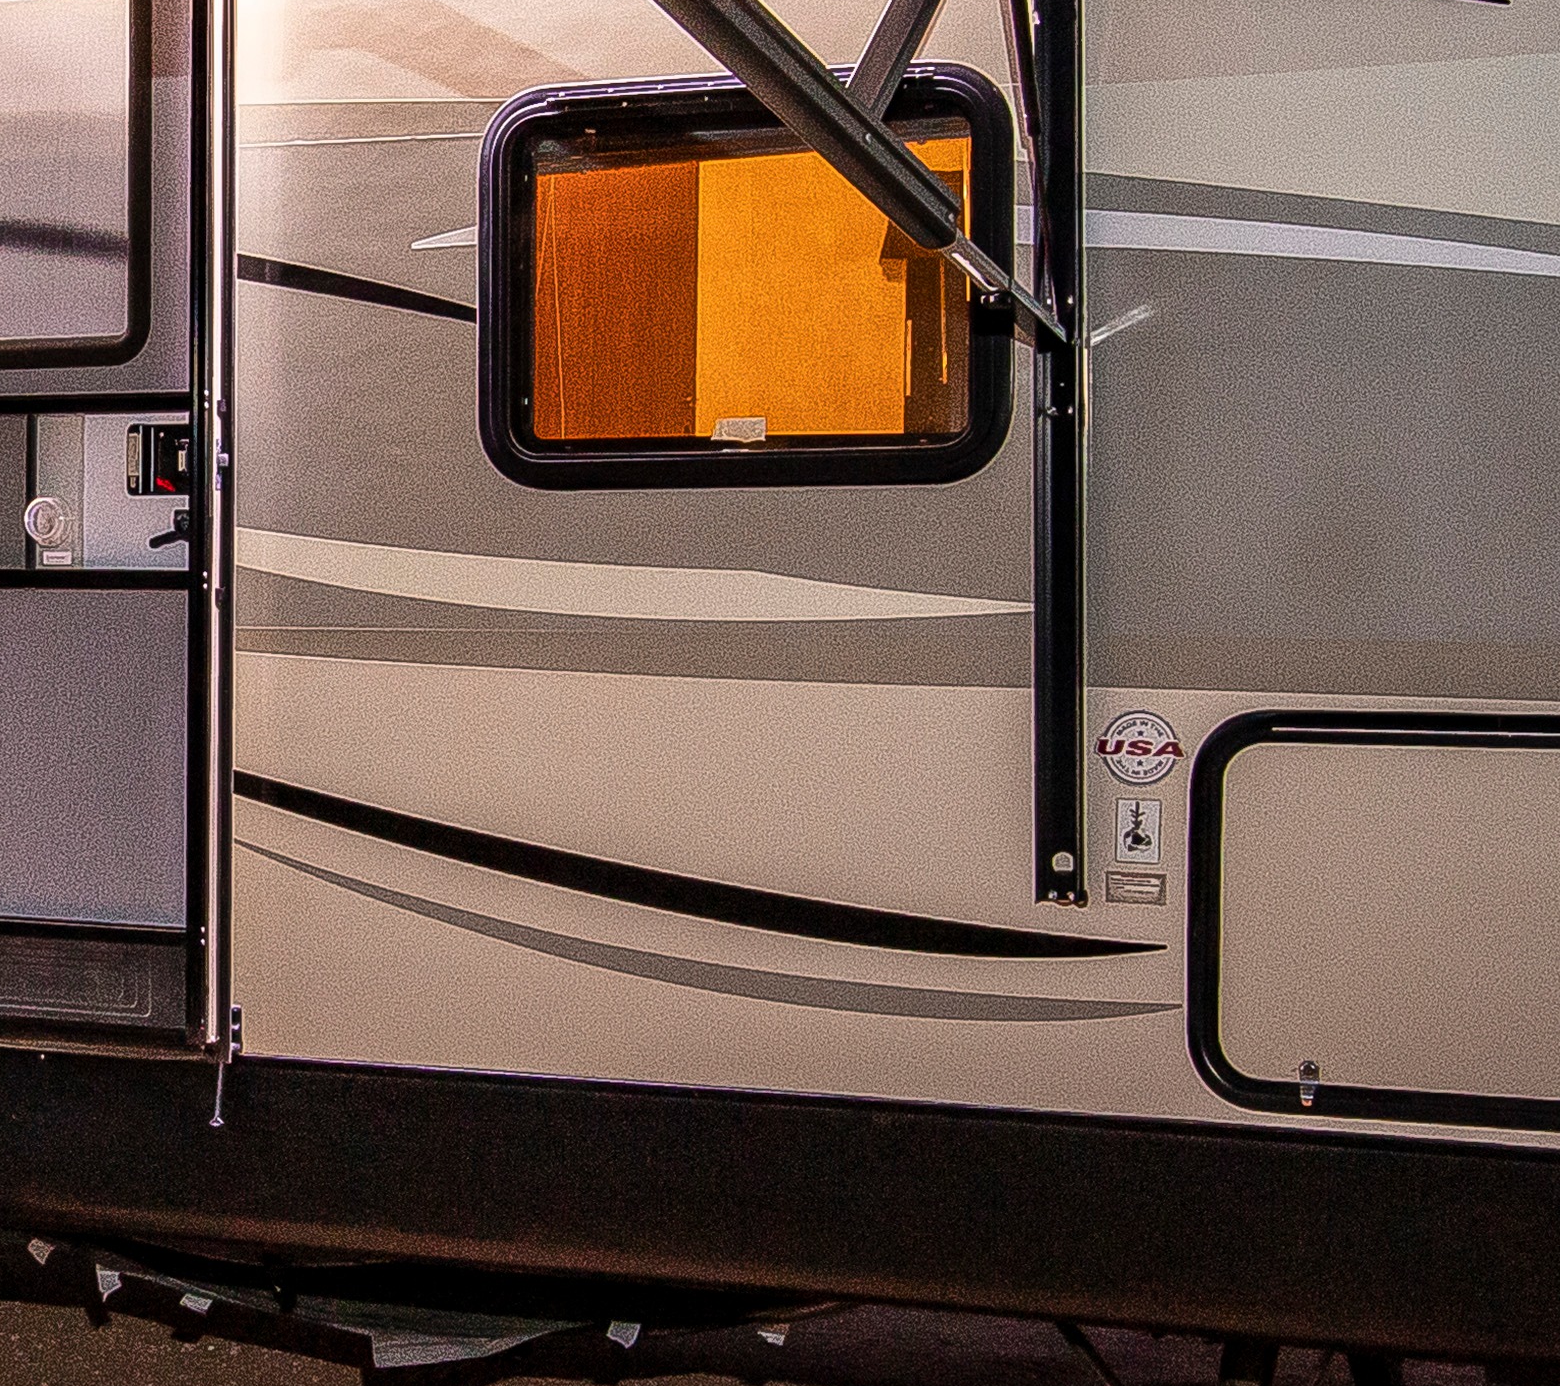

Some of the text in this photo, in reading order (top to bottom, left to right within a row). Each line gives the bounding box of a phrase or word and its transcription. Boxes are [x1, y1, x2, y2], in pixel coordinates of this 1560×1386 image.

[1116, 720, 1137, 736] MADE
[1150, 722, 1164, 738] THE
[1097, 739, 1184, 758] USA
